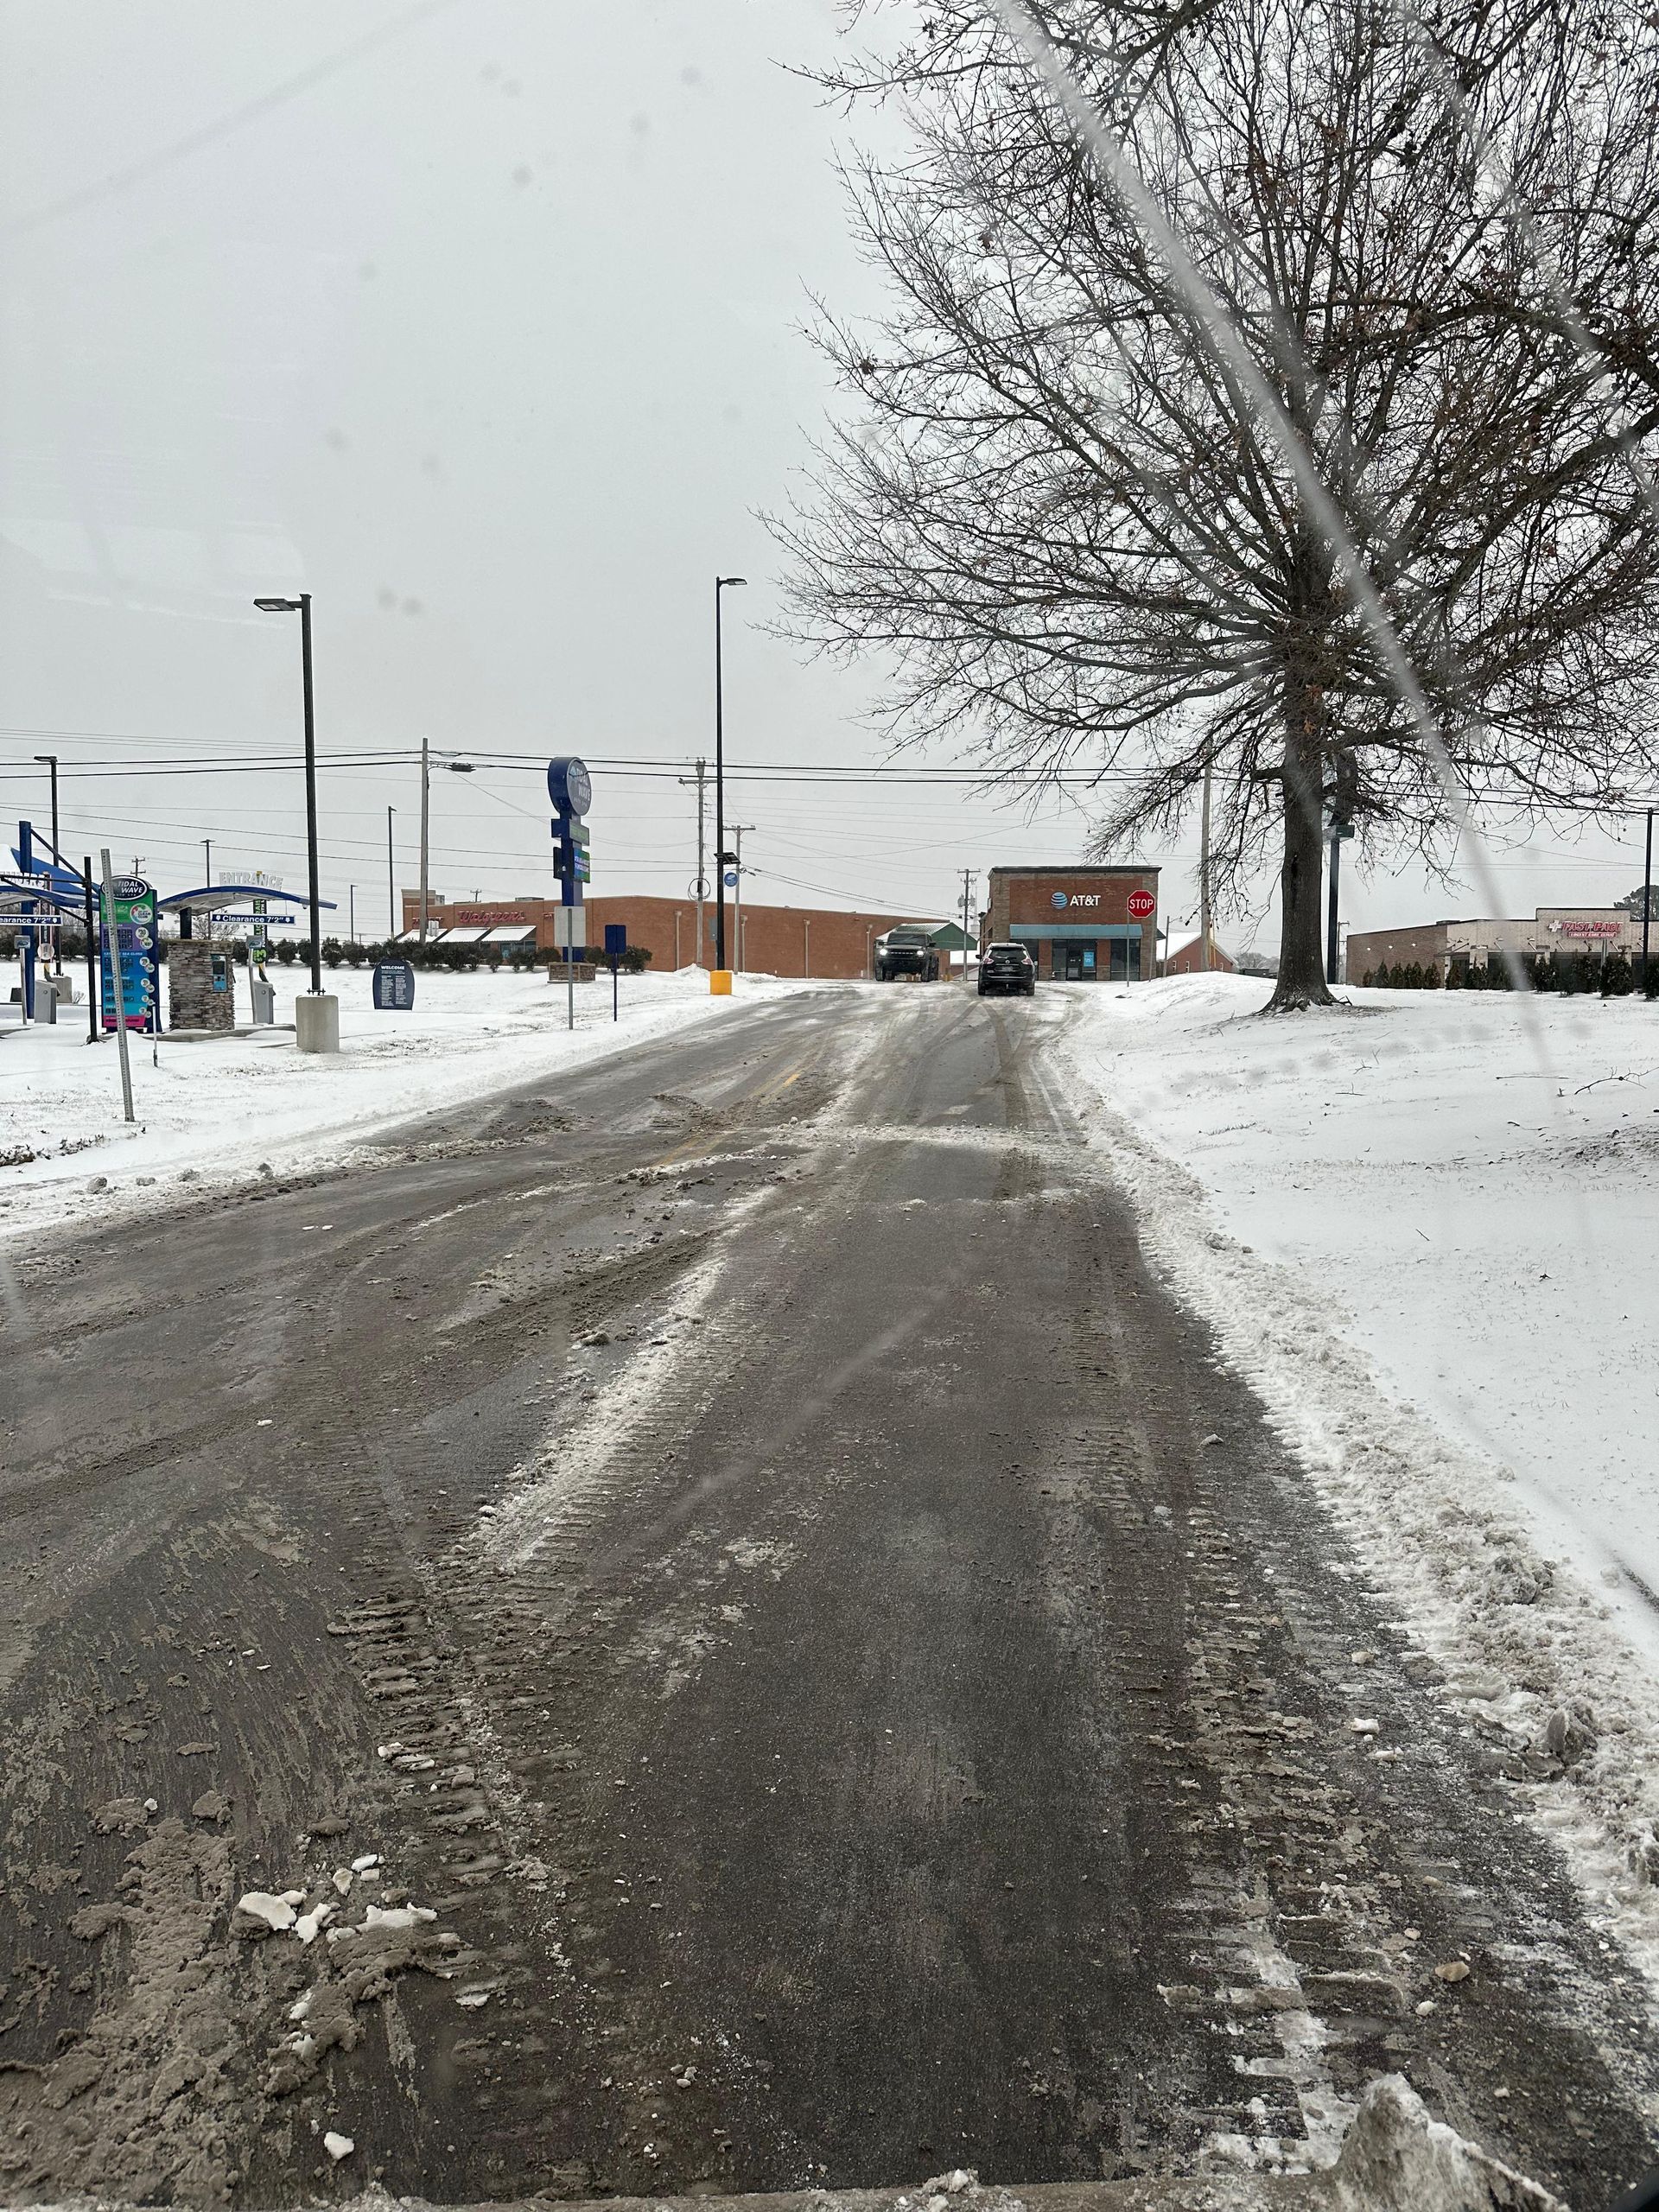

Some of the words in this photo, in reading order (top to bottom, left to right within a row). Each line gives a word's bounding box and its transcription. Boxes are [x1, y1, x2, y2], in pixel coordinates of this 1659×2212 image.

[219, 872, 283, 889] ENTRANCE
[1070, 895, 1102, 906] AT&T
[1128, 899, 1154, 910] STOP
[458, 911, 526, 925] Walgreens
[1562, 921, 1591, 931] FAST
